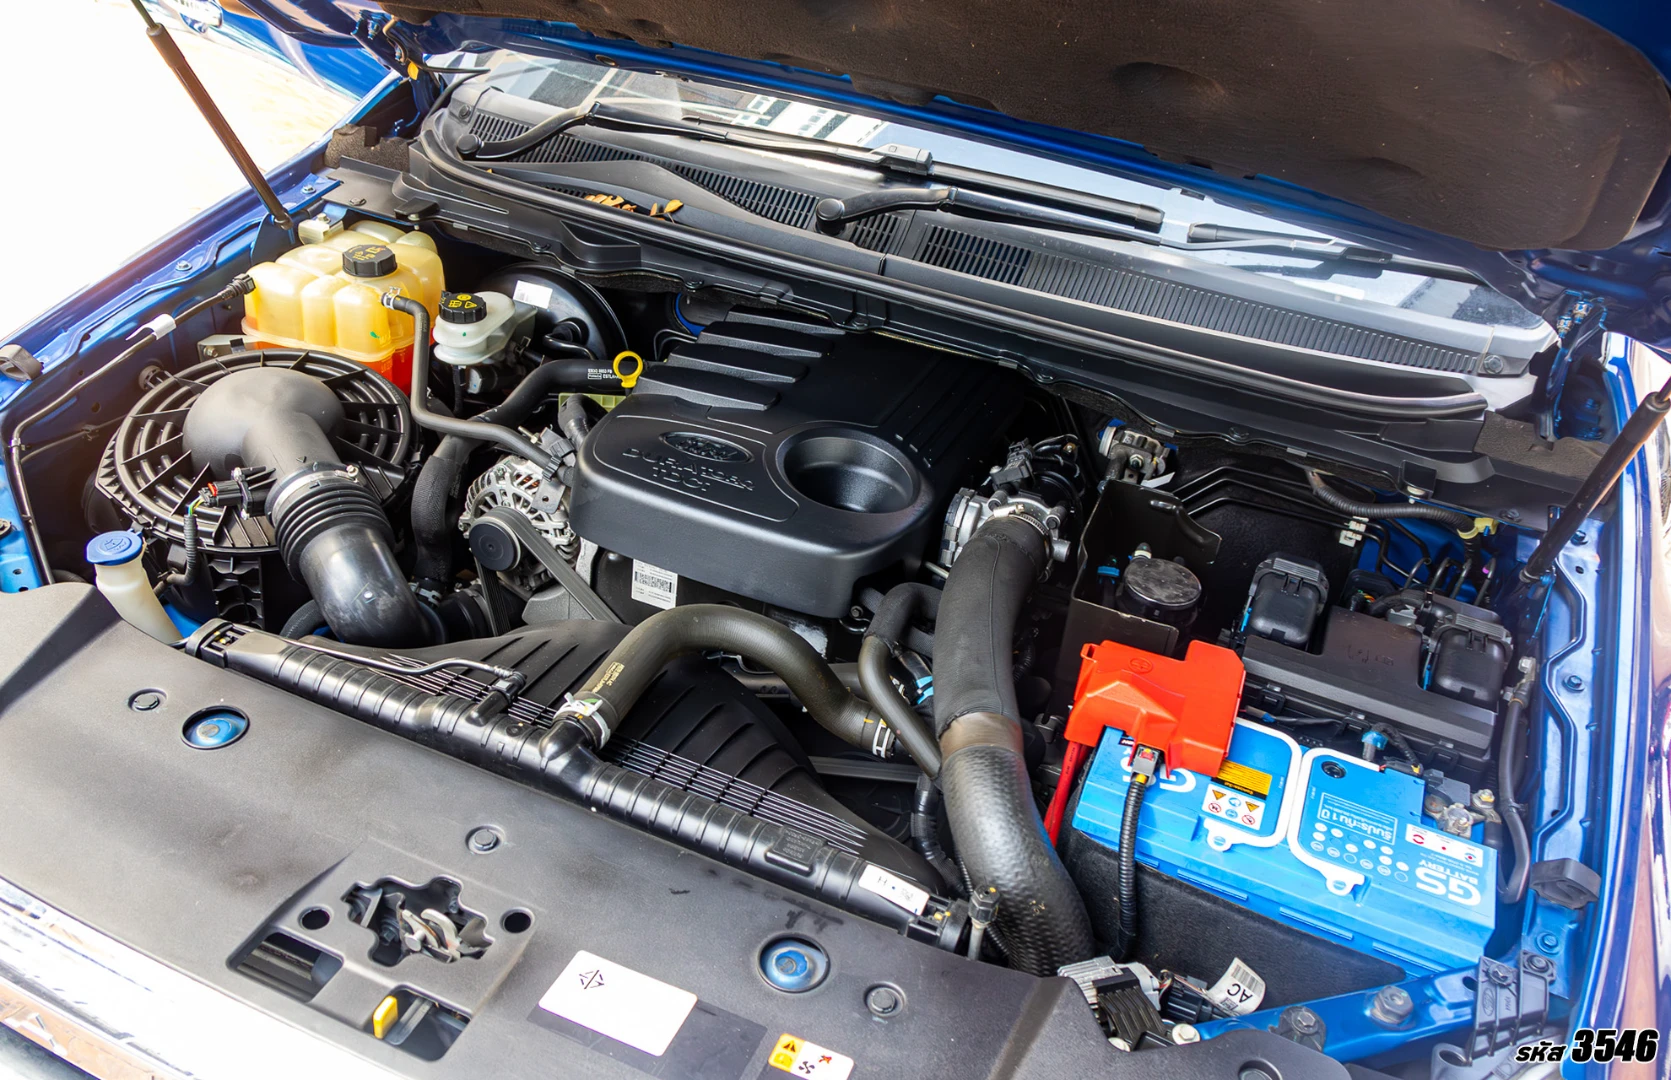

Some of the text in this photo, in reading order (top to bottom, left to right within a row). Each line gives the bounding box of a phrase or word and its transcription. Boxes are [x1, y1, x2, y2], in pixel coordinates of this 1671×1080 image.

[1418, 859, 1479, 885] BATTERY
[1415, 867, 1481, 906] GS
[1227, 982, 1253, 1003] AC
